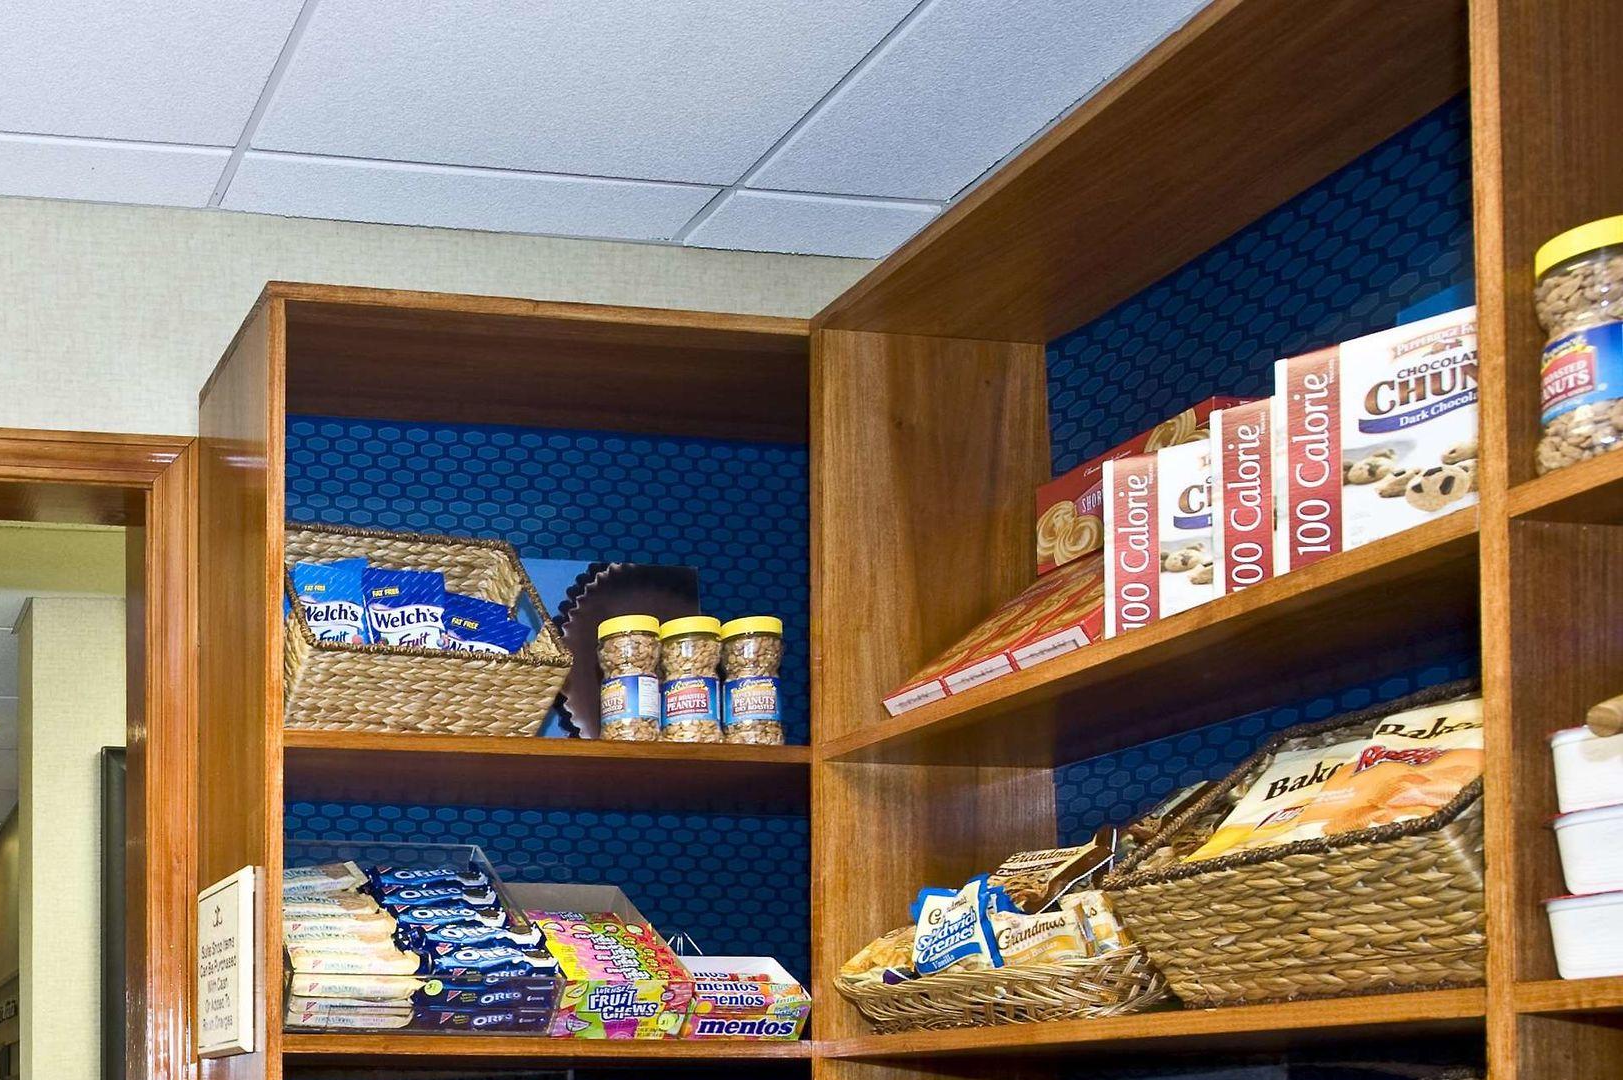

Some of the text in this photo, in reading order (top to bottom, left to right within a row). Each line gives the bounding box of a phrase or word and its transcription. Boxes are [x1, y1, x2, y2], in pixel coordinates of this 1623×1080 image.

[1399, 408, 1429, 427] Dark
[1292, 373, 1332, 556] 100 Calorie
[1227, 424, 1264, 593] 100 Calorie
[1118, 474, 1151, 631] 100 Calorie
[305, 603, 359, 622] Welch's
[374, 607, 439, 629] Welch's
[319, 630, 349, 643] Fruit
[398, 632, 430, 646] Fruit
[667, 698, 707, 712] PEANUTS
[733, 696, 775, 708] PEANUTS
[400, 887, 461, 898] OREO
[412, 907, 476, 919] OREO
[486, 969, 526, 983] OREO
[697, 983, 759, 991] mentos
[481, 992, 522, 1004] OREO
[701, 994, 765, 1006] mentos
[603, 1003, 657, 1020] CHEWS
[697, 1016, 795, 1035] mentos
